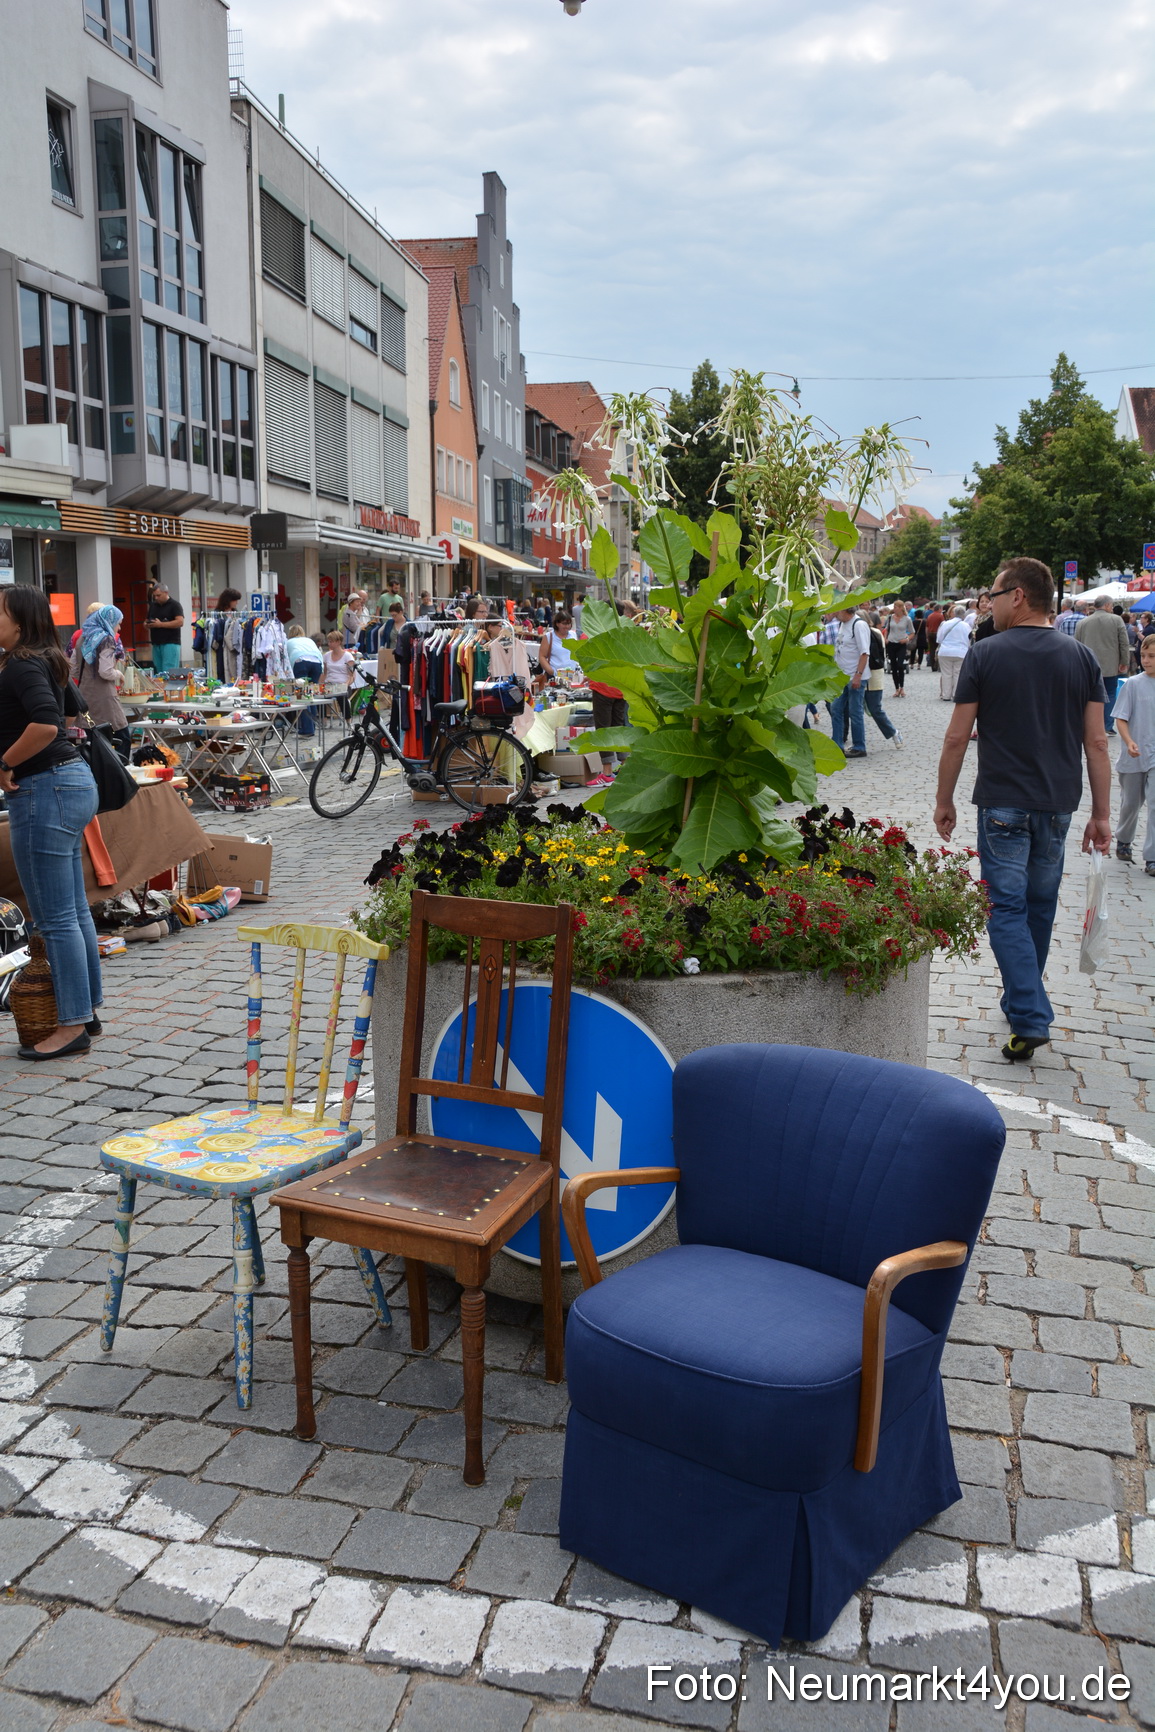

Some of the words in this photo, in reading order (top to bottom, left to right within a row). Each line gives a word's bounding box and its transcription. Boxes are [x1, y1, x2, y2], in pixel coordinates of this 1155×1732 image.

[129, 513, 186, 537] ESPRIT
[1145, 560, 1155, 568] TAX
[253, 596, 260, 608] P
